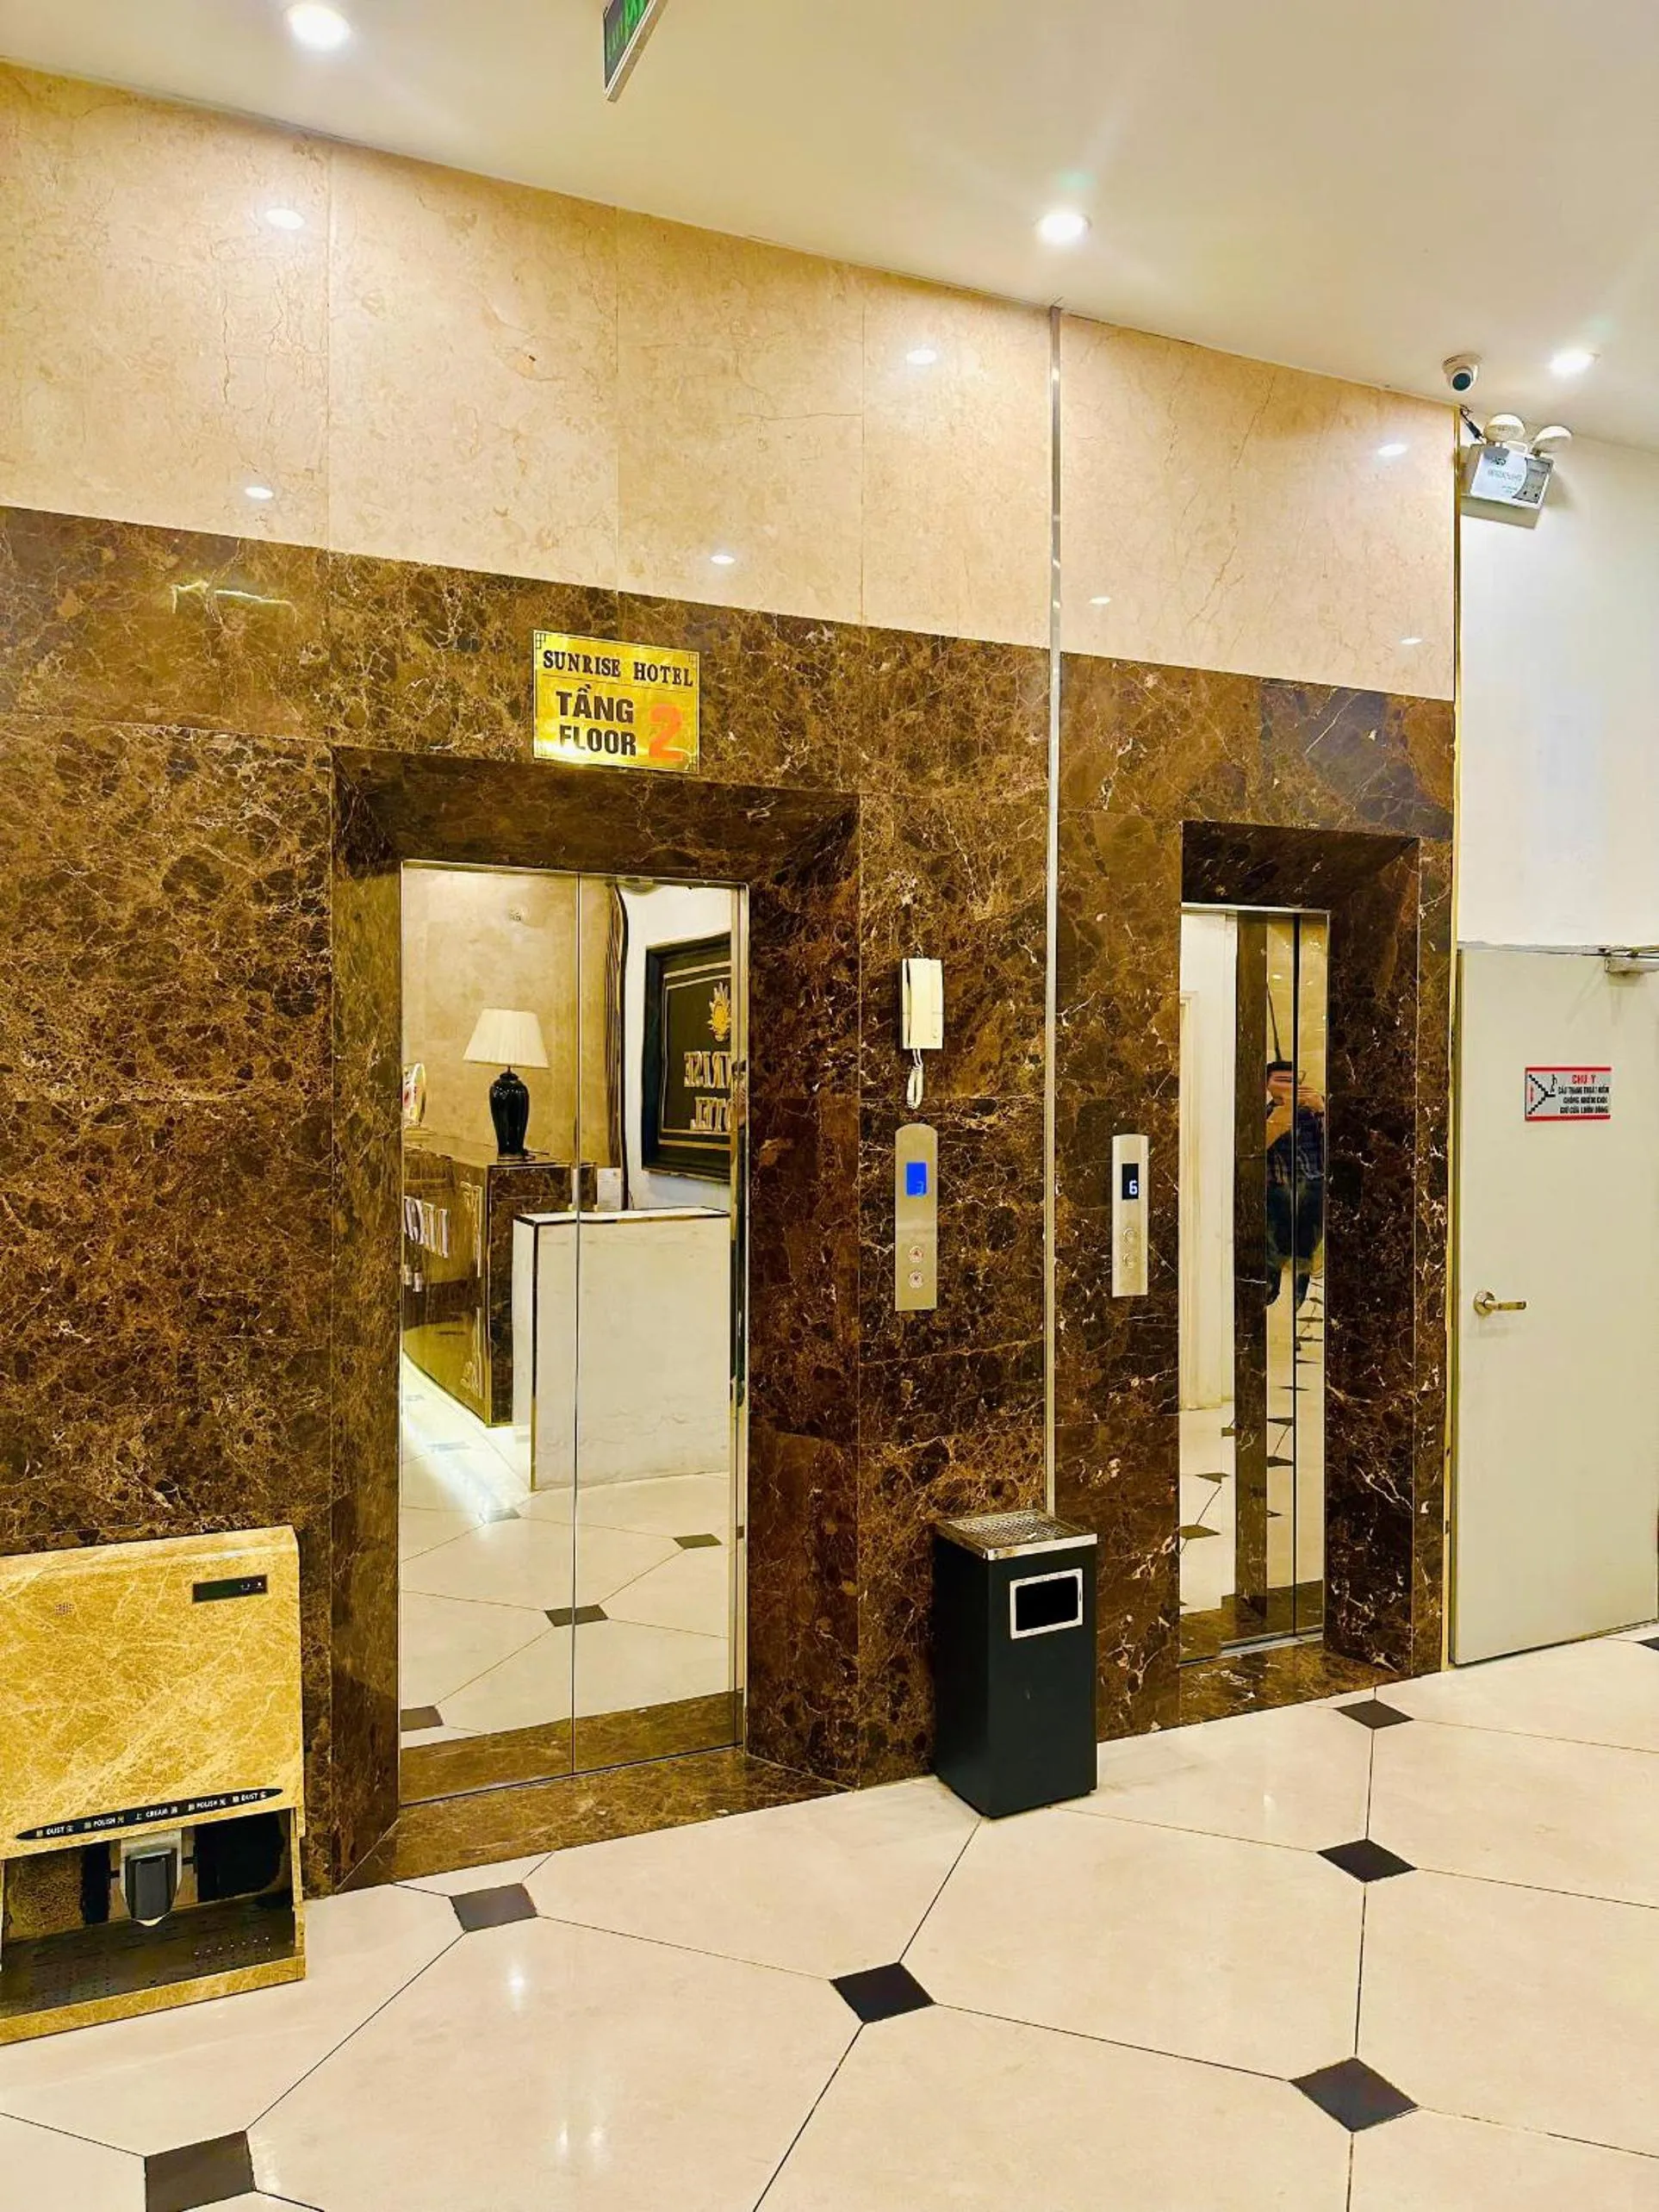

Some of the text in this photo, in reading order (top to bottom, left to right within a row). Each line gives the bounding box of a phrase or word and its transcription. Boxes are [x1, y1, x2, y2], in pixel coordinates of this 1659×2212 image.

[543, 649, 693, 687] SUNRISE HOTEL
[556, 683, 634, 724] TẦNG
[559, 724, 637, 756] FLOOR
[649, 702, 683, 760] 2
[1128, 1179, 1138, 1196] 6
[146, 1807, 168, 1818] CREAM
[196, 1799, 218, 1810] POLISH
[241, 1793, 258, 1802] DUST
[46, 1825, 65, 1836] DUST
[93, 1817, 116, 1827] POLISH
